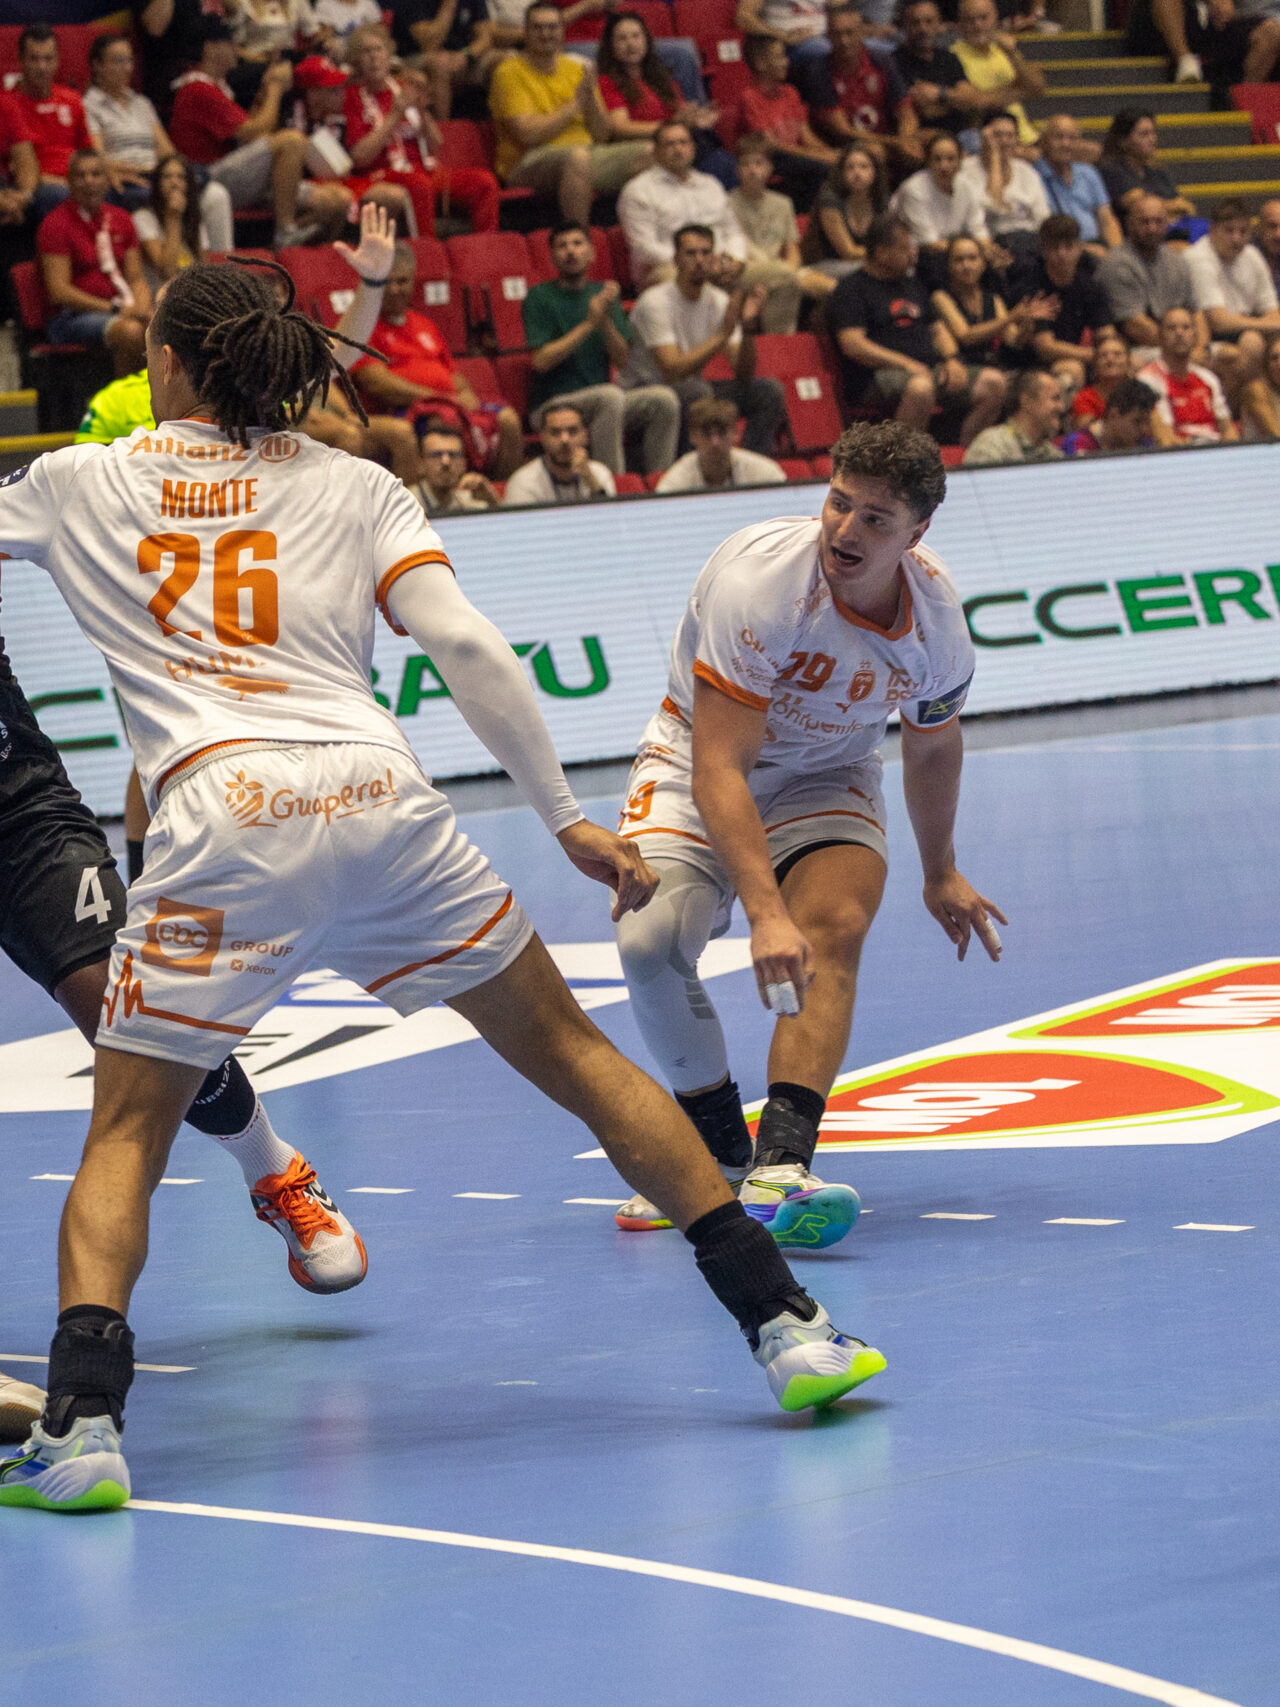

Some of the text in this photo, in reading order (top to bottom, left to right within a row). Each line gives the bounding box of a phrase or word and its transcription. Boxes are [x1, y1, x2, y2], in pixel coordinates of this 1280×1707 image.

[127, 435, 249, 461] Allianz
[160, 477, 259, 519] MONTE
[136, 529, 280, 648] 26
[962, 564, 1280, 648] CCER
[270, 768, 398, 827] Guaperal
[74, 866, 112, 924] 4
[157, 922, 209, 949] cbc
[230, 939, 294, 958] GROUP
[245, 962, 277, 976] xerox
[817, 1078, 1083, 1134] MOL
